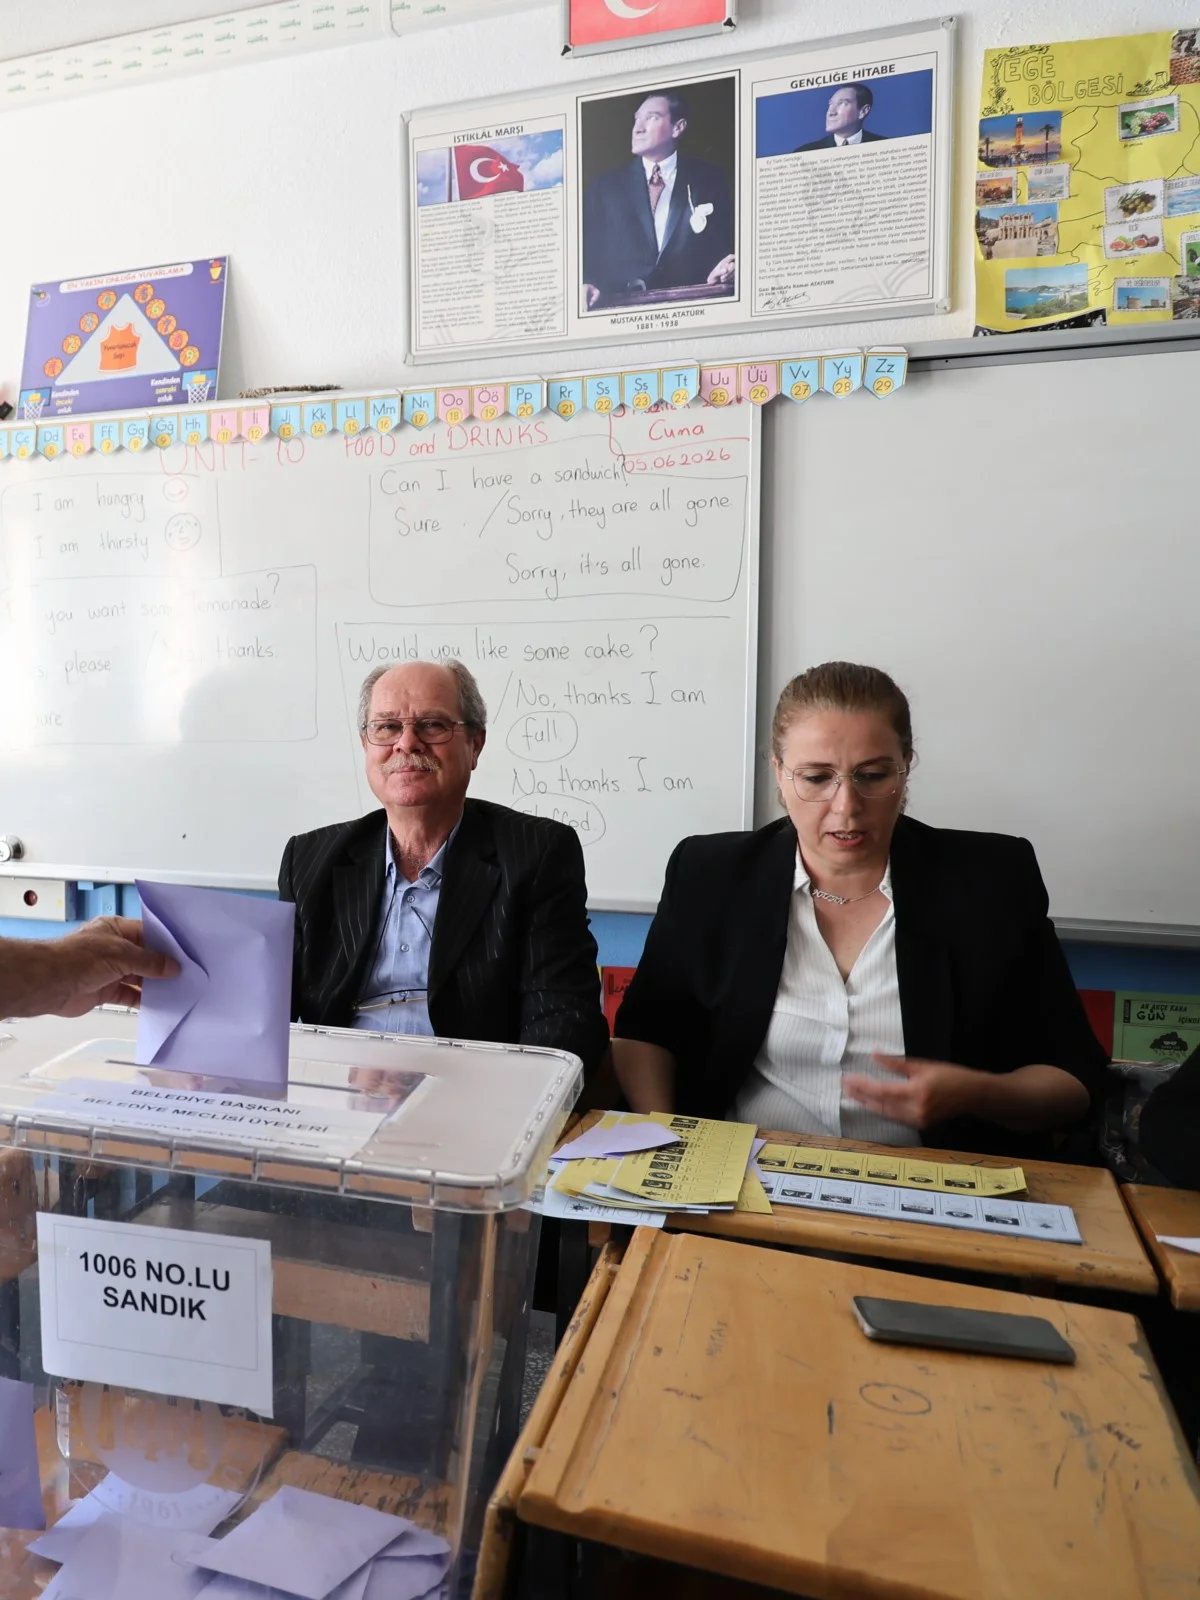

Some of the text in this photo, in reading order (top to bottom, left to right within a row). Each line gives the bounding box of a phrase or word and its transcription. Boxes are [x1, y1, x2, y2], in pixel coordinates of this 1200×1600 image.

[790, 64, 896, 89] GENÇLİĞE HİTABE
[1003, 55, 1056, 82] EGE
[1028, 72, 1124, 106] BÖLGESİ
[495, 125, 524, 137] MARŞI
[610, 315, 644, 325] MUSTAFA
[645, 313, 670, 322] KEMAL
[637, 320, 678, 331] 1881 1938
[44, 431, 59, 442] Dd
[72, 429, 85, 440] Ee
[101, 425, 113, 438] Ff
[127, 424, 145, 440] Gg
[185, 418, 200, 430] Hh
[281, 409, 291, 424] Jj
[312, 408, 327, 421] Kk
[373, 403, 396, 416] Mm
[412, 396, 430, 409] Nn
[443, 393, 463, 406] Oo
[478, 387, 499, 403] Öö
[517, 387, 533, 405] Pp
[560, 386, 573, 399] Rr
[596, 381, 610, 395] Ss
[675, 373, 688, 387] Tt
[710, 372, 730, 387] Uu
[748, 366, 768, 383] Üü
[789, 365, 810, 380] Vv
[833, 361, 852, 379] Yy
[875, 358, 895, 374] Zz
[190, 434, 198, 443] 10
[221, 432, 228, 440] 11
[251, 430, 260, 439] 12
[282, 427, 291, 436] 13
[314, 425, 323, 433] 14
[347, 423, 357, 431] 15
[380, 420, 389, 429] 16
[414, 415, 424, 424] 17
[450, 412, 460, 420] 18
[485, 409, 495, 418] 19
[519, 406, 531, 416] 20
[562, 404, 572, 414] 21
[597, 401, 611, 411] 22
[636, 396, 648, 406] 23
[675, 393, 687, 403] 24
[712, 392, 726, 402] 25
[752, 388, 767, 399] 26
[794, 385, 809, 396] 27
[835, 382, 851, 394] 28
[876, 380, 892, 391] 29
[409, 432, 435, 456] and
[448, 421, 548, 451] DRINKS
[648, 419, 704, 440] Cuma
[380, 454, 629, 495] Can I have a sandwich?
[34, 481, 146, 522] I am hungry
[569, 495, 607, 530] they
[612, 499, 639, 515] are
[649, 486, 672, 511] all
[60, 540, 79, 553] am
[99, 533, 149, 561] thirsty
[506, 546, 706, 601] Sorry, it's all gone.
[44, 610, 74, 635] you
[88, 600, 127, 619] want
[348, 633, 418, 660] Would
[475, 627, 509, 659] like
[524, 641, 570, 661] some
[65, 650, 111, 684] please
[641, 670, 662, 705] I
[671, 688, 707, 705] am
[512, 769, 548, 796] No
[629, 756, 652, 792] I
[663, 777, 694, 791] am
[1136, 1007, 1166, 1021] GÜN
[83, 1097, 167, 1115] BELEDİYE
[171, 1108, 245, 1125] MECLİSİ
[249, 1116, 329, 1134] ÜYELERİ
[131, 1089, 302, 1117] BELEDİYE BAŞKANI
[79, 1251, 230, 1291] 1006 NO.LU
[103, 1286, 207, 1321] SANDIK
